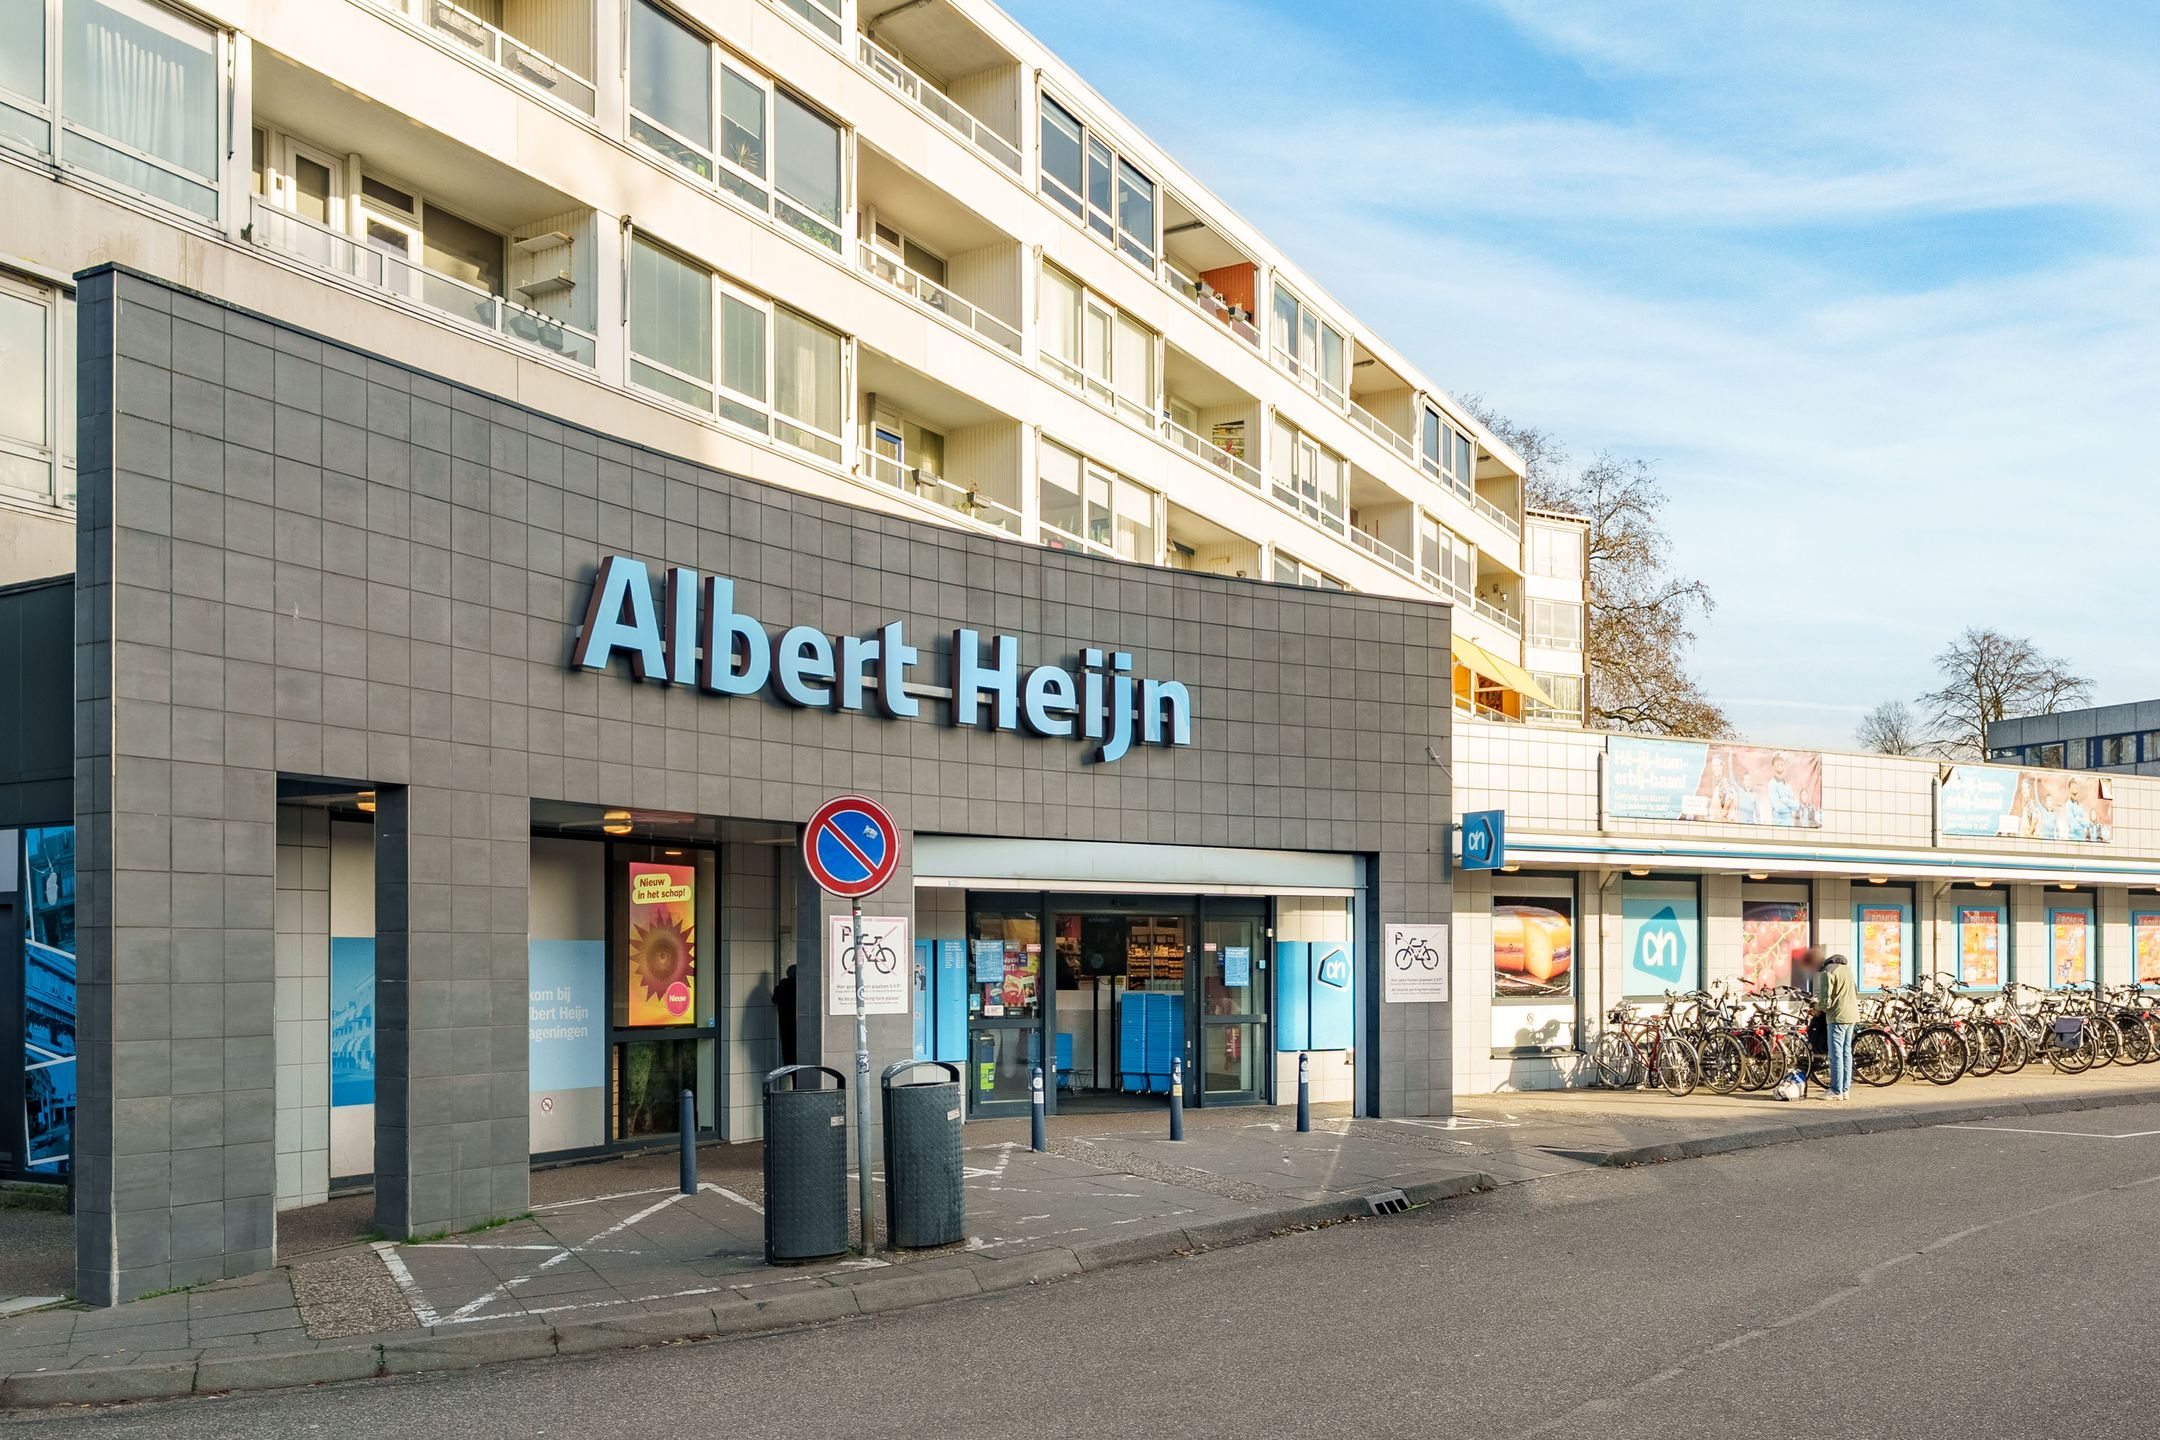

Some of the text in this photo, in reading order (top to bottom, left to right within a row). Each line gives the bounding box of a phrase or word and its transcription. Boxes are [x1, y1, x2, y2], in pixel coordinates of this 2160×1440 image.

[573, 555, 1191, 763] Albert Heijn
[640, 878, 665, 887] Nieuw
[637, 889, 686, 899] in het schap!
[1871, 914, 1898, 922] BONUS
[2061, 916, 2084, 924] BONUS
[557, 987, 571, 1004] bij
[560, 1005, 588, 1021] Heijn
